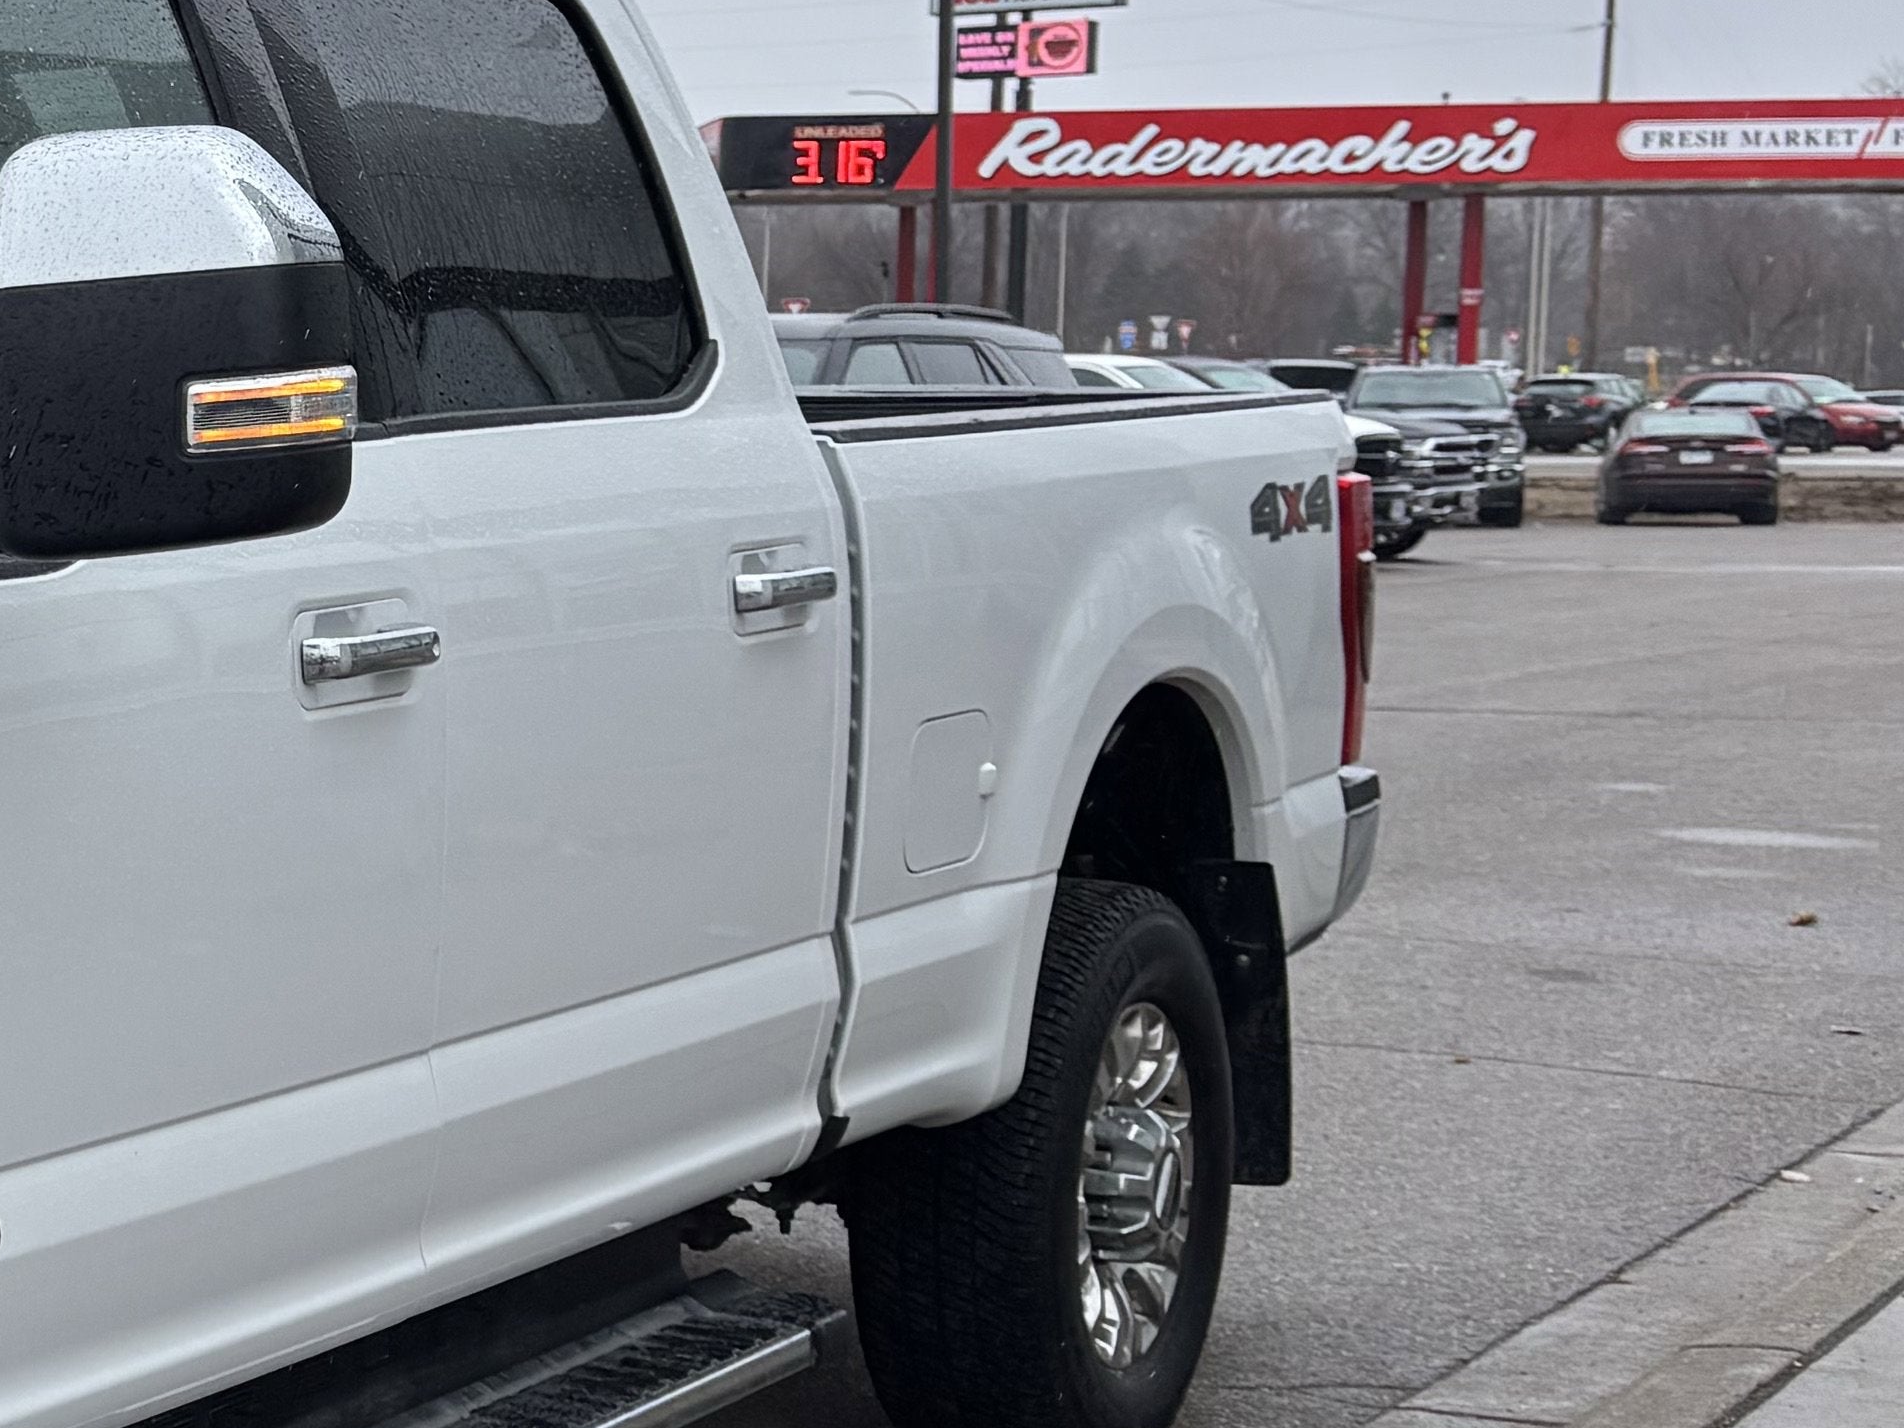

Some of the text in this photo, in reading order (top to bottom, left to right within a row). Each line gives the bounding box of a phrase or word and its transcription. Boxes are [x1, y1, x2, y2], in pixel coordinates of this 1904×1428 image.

[794, 125, 885, 139] UNLEADED
[1642, 129, 1728, 149] FRESH
[1742, 127, 1860, 147] MARKET
[978, 116, 1537, 179] Radermacher's
